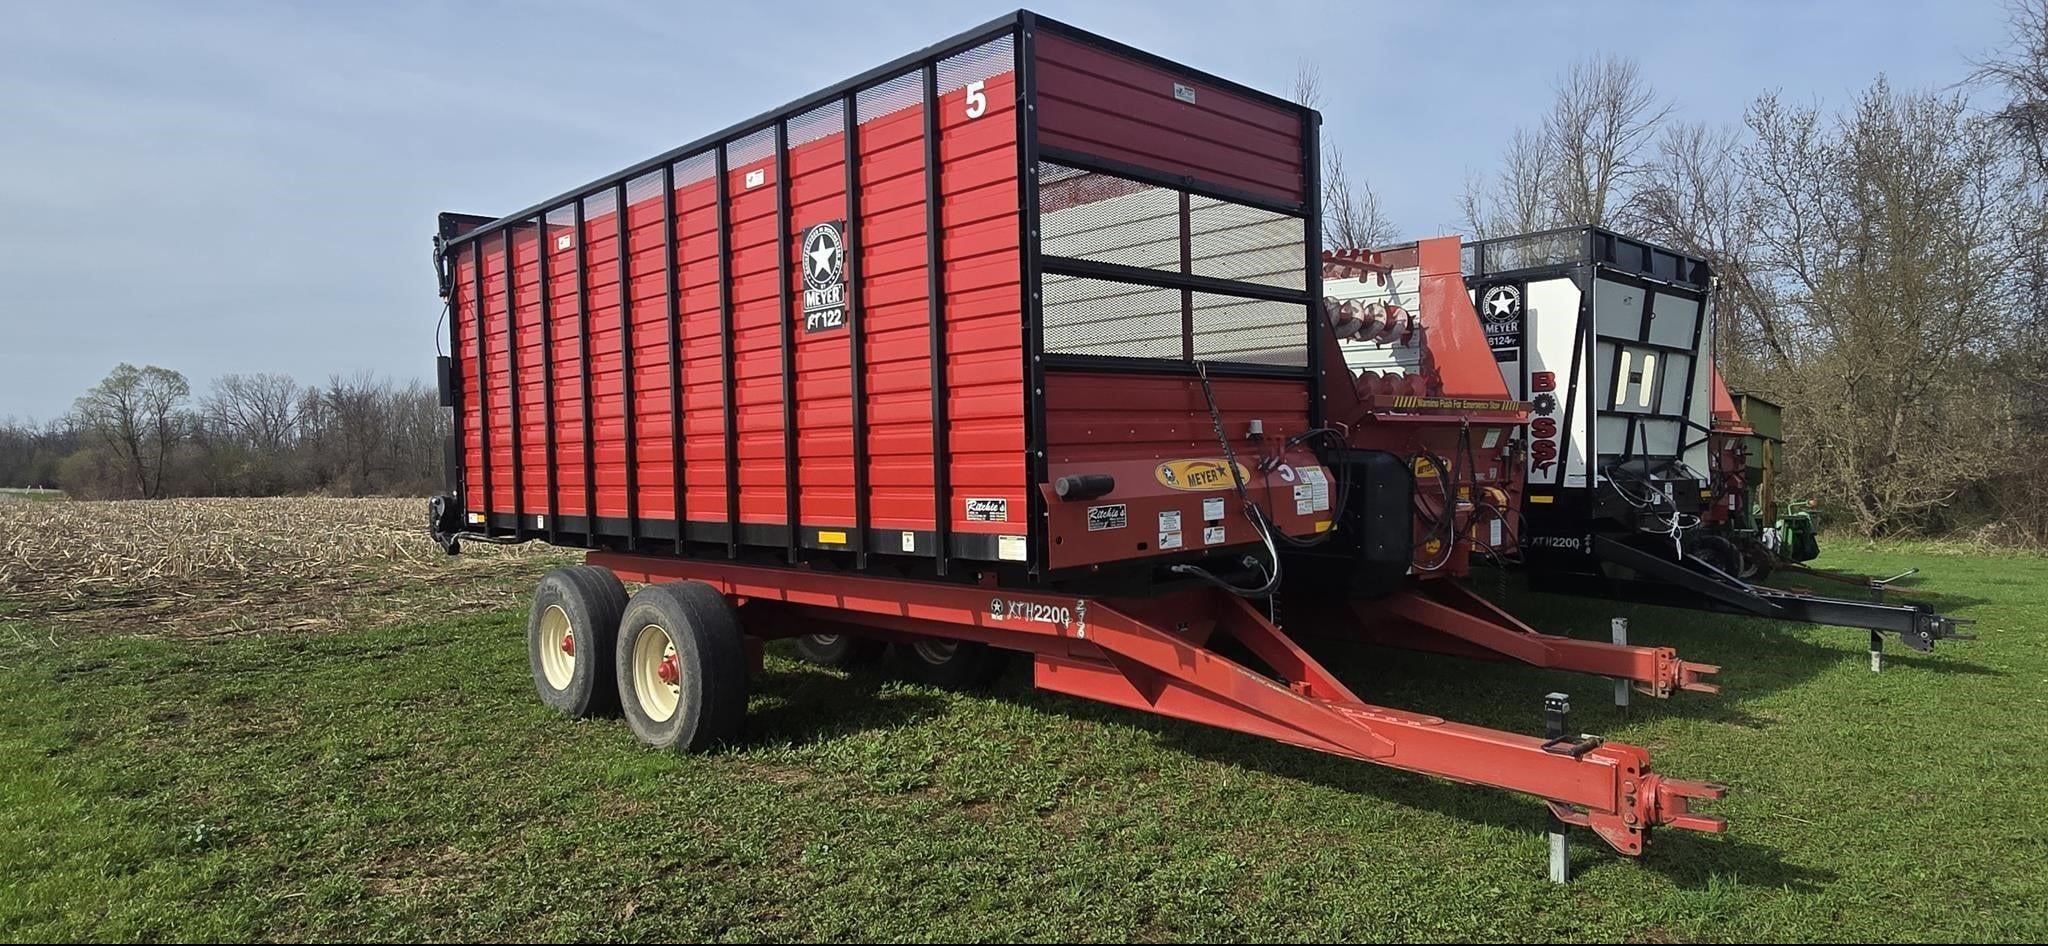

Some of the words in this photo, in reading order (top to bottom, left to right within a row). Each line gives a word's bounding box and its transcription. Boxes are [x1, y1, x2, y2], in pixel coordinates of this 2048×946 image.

[966, 81, 987, 119] 5
[806, 287, 840, 308] MEYER
[1485, 322, 1518, 334] MEYER
[1453, 400, 1462, 409] For
[1187, 469, 1219, 487] MEYER
[968, 499, 1005, 512] Ritchie's
[1088, 505, 1125, 520] Ritchie's
